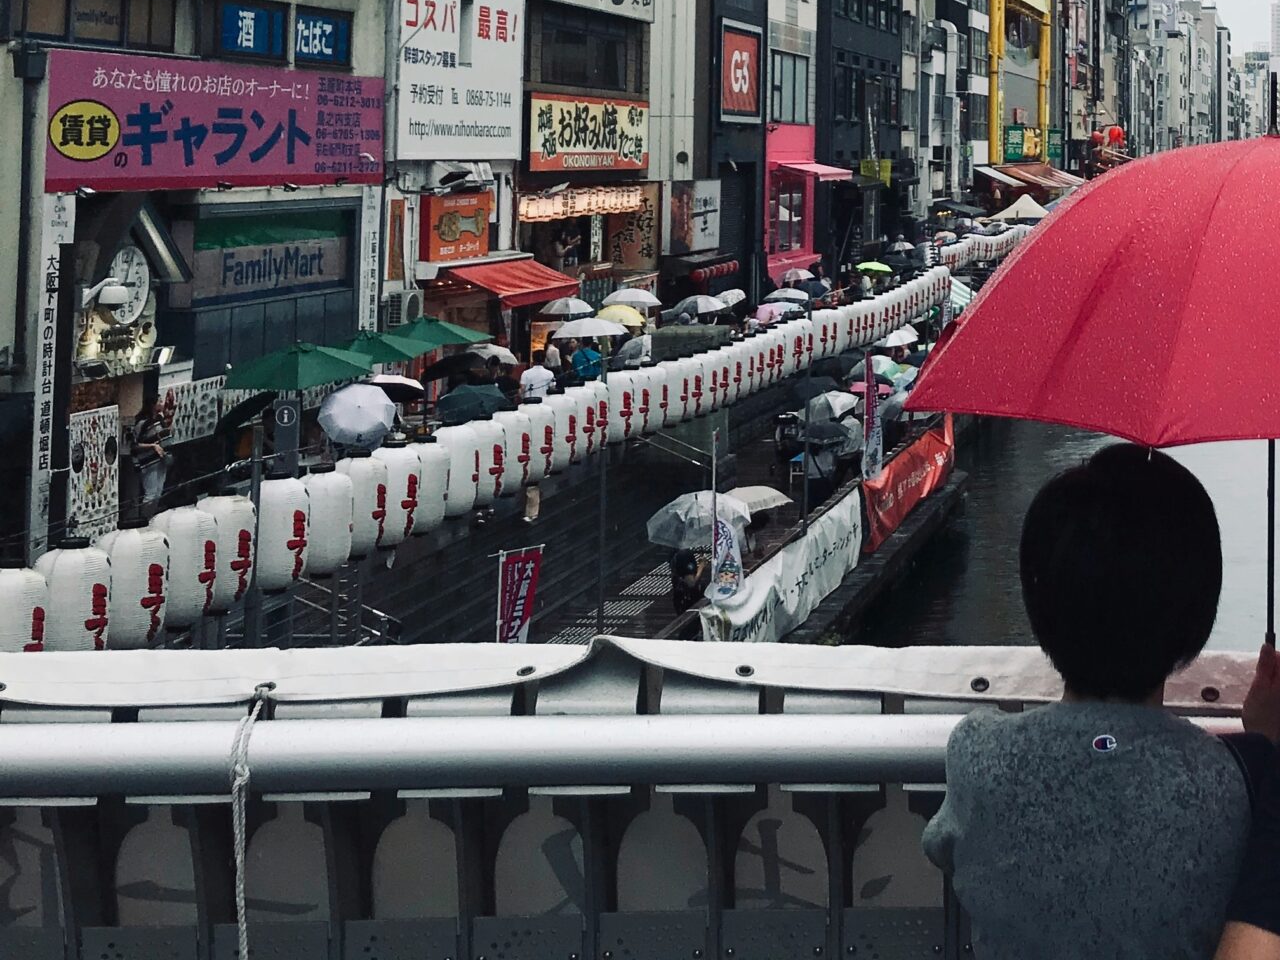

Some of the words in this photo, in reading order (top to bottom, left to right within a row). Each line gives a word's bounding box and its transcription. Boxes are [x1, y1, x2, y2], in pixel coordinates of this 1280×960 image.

[237, 11, 256, 49] 酒
[296, 19, 333, 55] たばこ
[730, 49, 750, 94] G3
[465, 88, 511, 108] 0868-75-1144
[59, 113, 112, 148] 賃貸
[114, 149, 128, 168] の
[122, 99, 312, 167] ギャラント
[557, 102, 618, 151] お好み焼
[562, 153, 616, 168] OKONOMIYAKI
[221, 245, 324, 287] FamilyMart
